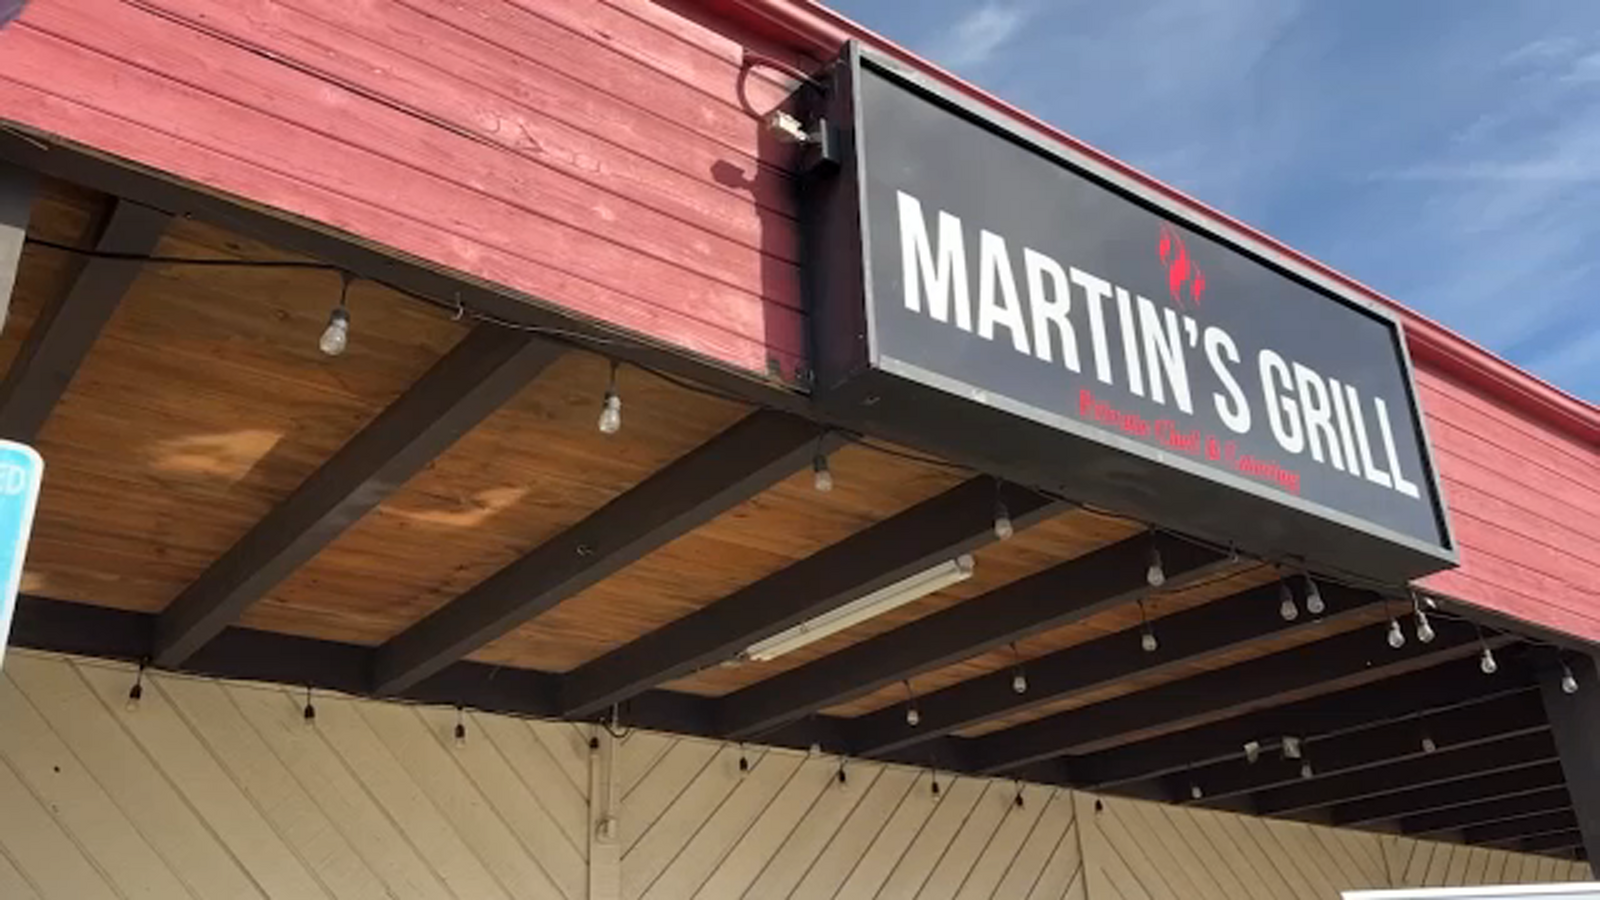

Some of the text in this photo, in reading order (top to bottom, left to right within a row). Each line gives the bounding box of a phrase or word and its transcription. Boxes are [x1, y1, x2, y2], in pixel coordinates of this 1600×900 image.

[896, 189, 1420, 499] MARTIN'S GRILL
[1078, 388, 1150, 438] Private
